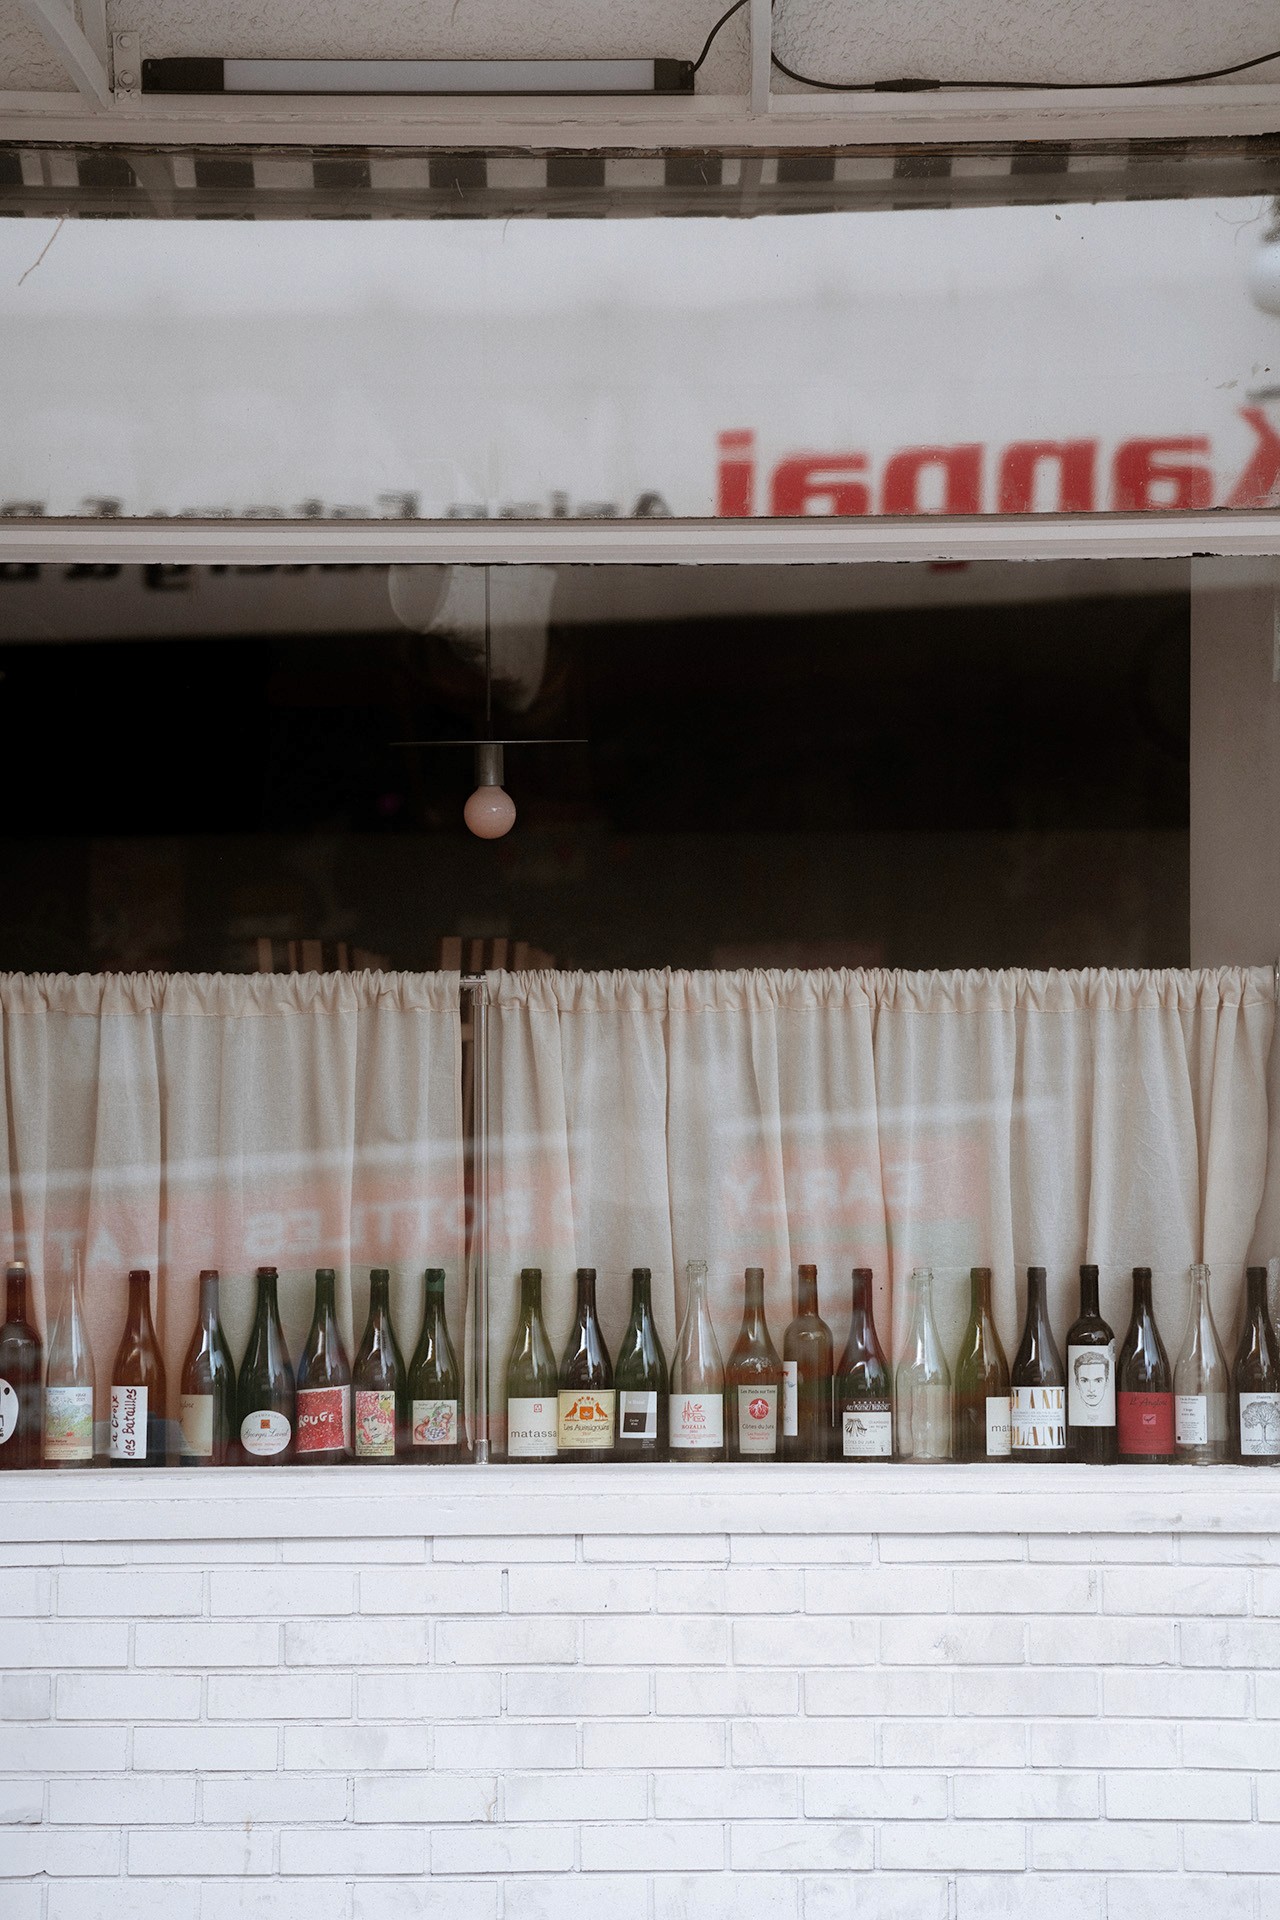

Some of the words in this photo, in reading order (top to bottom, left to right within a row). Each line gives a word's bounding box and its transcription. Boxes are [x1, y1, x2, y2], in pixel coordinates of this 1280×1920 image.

[121, 1387, 137, 1436] Batailles
[298, 1411, 335, 1428] ROUGE
[510, 1429, 557, 1438] matassa
[123, 1439, 136, 1457] des
